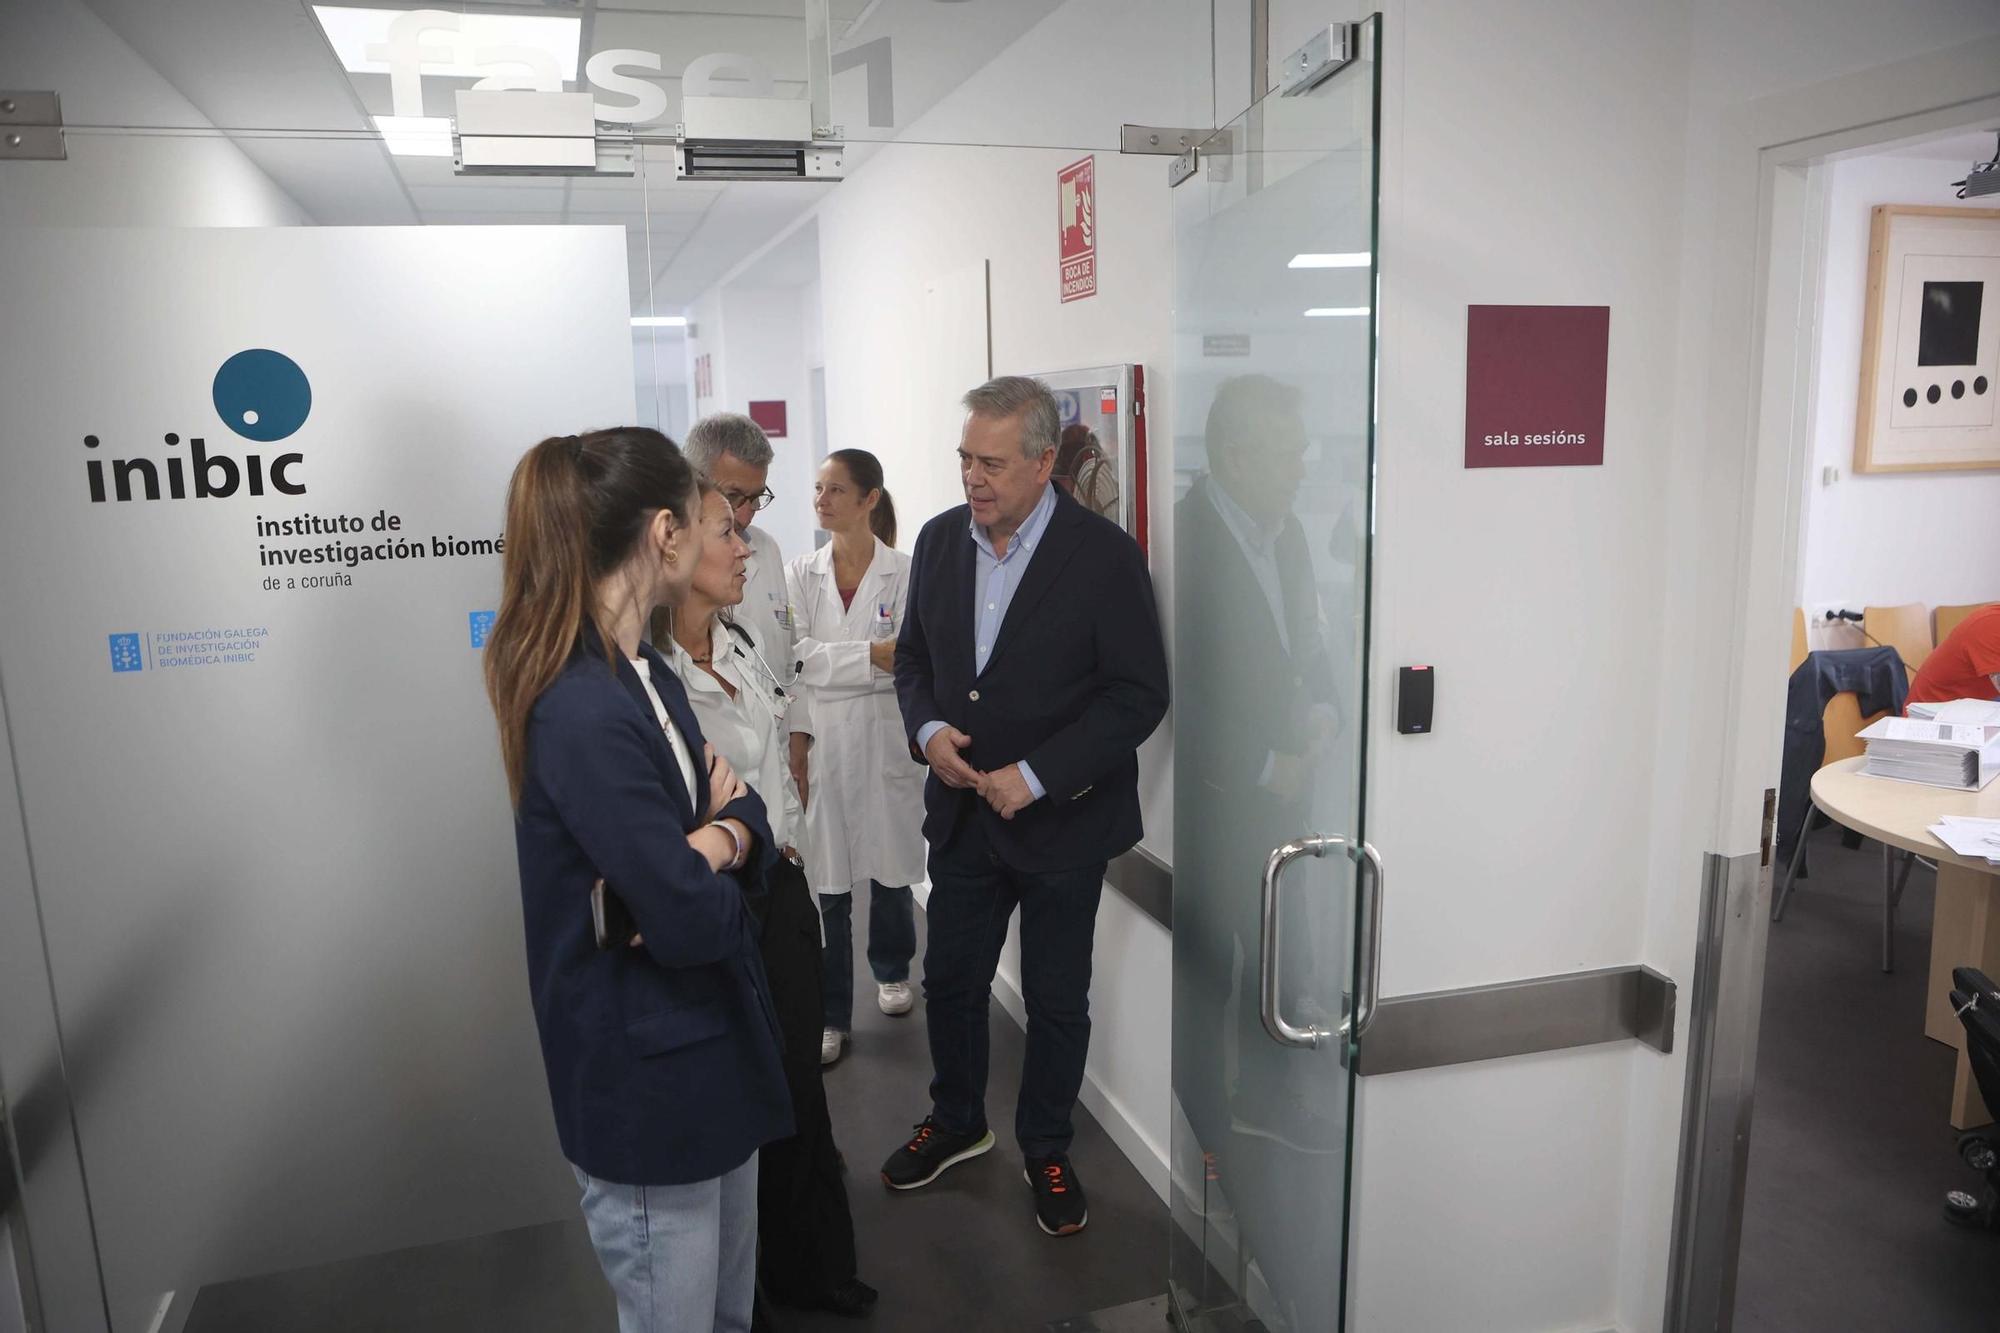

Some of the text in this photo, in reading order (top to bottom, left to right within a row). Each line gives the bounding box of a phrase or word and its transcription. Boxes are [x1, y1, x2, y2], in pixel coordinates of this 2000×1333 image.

[829, 36, 894, 128] 1
[1065, 261, 1091, 281] BOCA DE
[1063, 275, 1093, 295] INCENDIOS
[1484, 430, 1586, 446] sala sesións
[84, 433, 307, 504] inibic
[256, 510, 401, 537] instituto de
[259, 538, 426, 568] investigación
[262, 572, 353, 591] de a coruña
[156, 627, 270, 643] FUNDACIÓN GALEGA
[158, 640, 260, 656] DE INVESTIGACIÓN
[159, 652, 256, 668] BIOMÉDICA INIBIC
